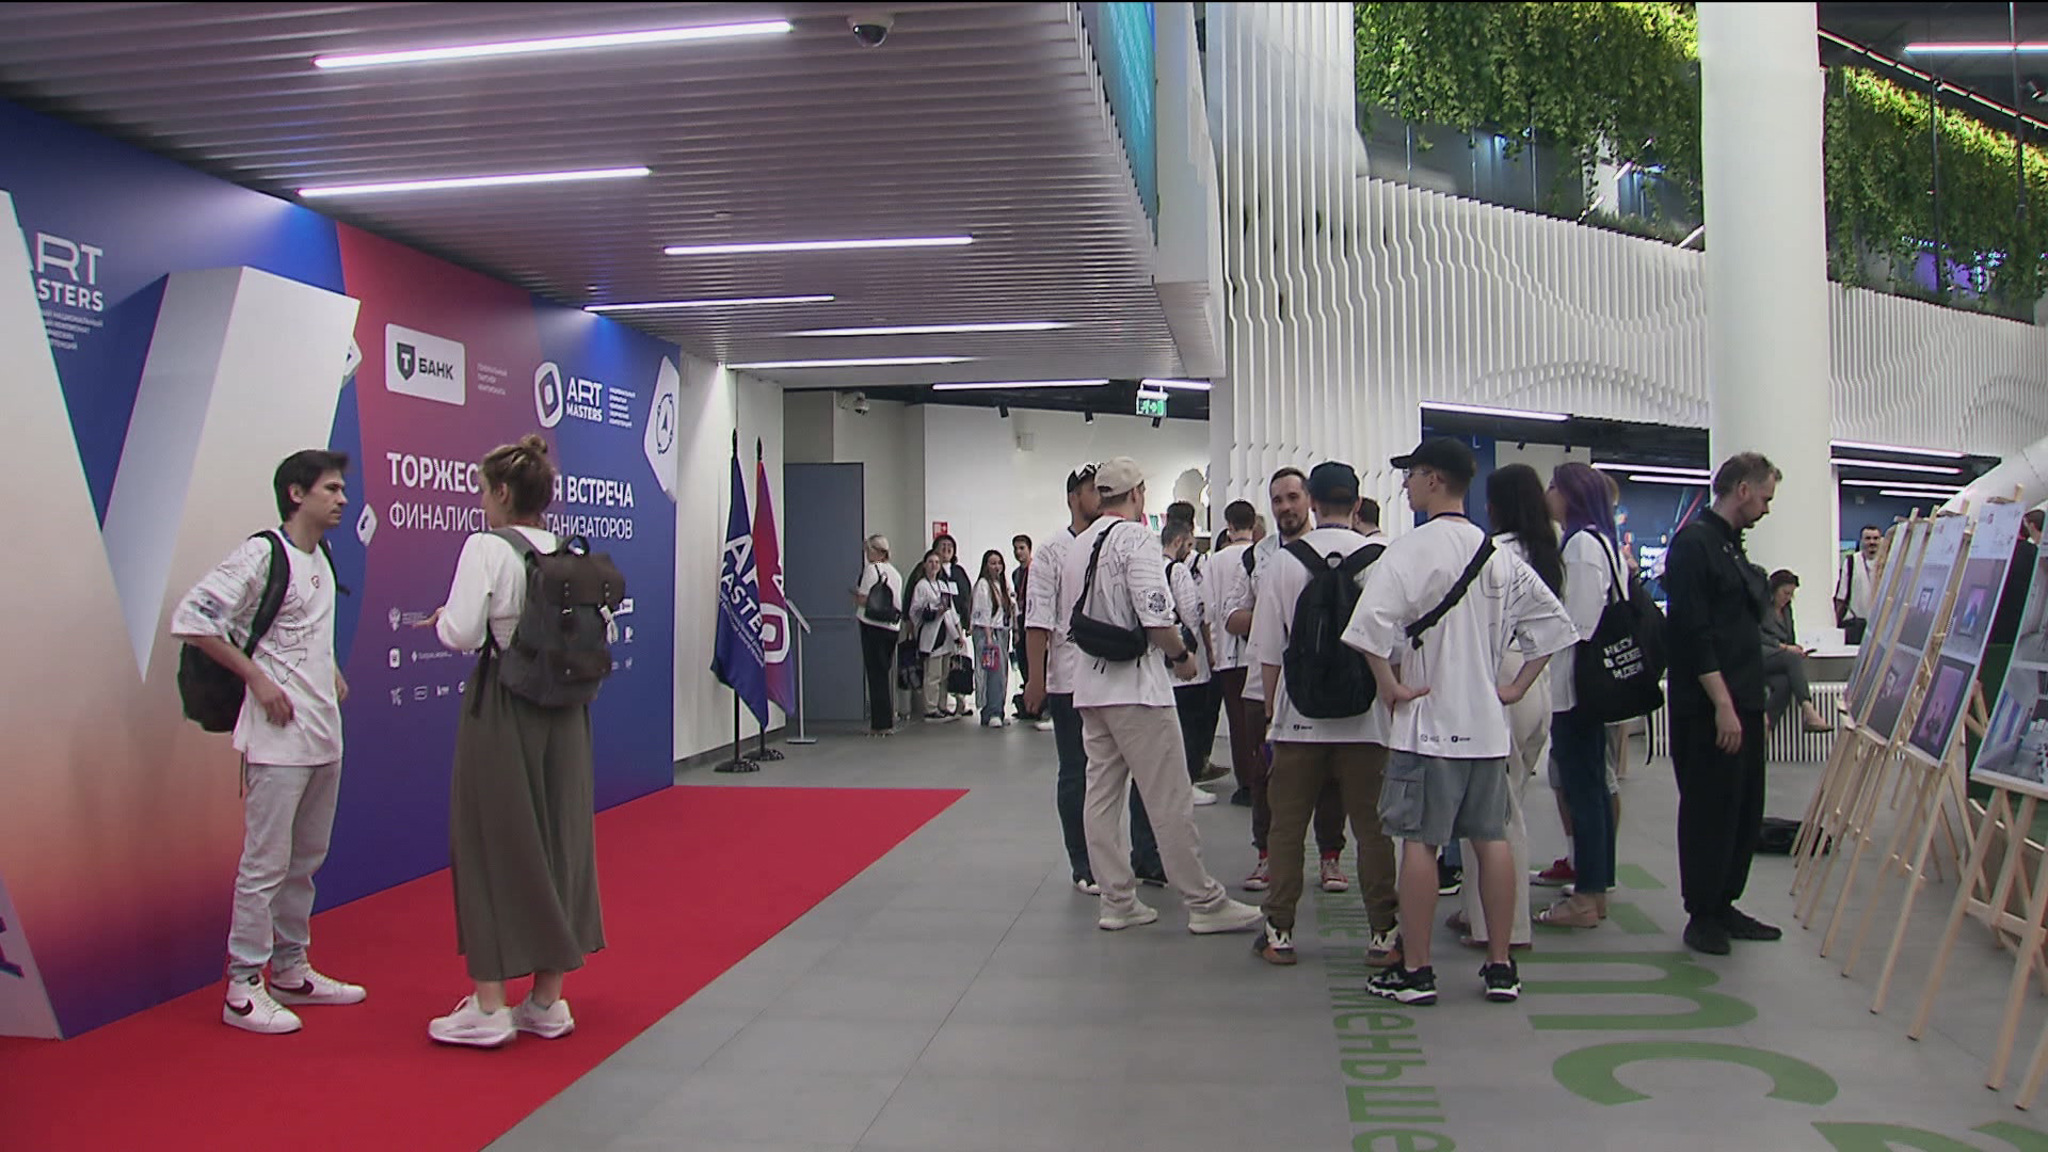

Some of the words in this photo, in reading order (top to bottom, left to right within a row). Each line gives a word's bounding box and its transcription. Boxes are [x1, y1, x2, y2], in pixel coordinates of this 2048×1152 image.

[36, 232, 104, 286] RT
[37, 279, 104, 312] STERS
[418, 356, 454, 381] БАНК
[566, 376, 603, 407] ART
[566, 402, 603, 423] MASTERS
[567, 475, 634, 508] ВСТРЕЧА
[389, 500, 494, 533] ФИНАЛИСТ
[546, 512, 633, 540] ГАНИЗАТОРОВ
